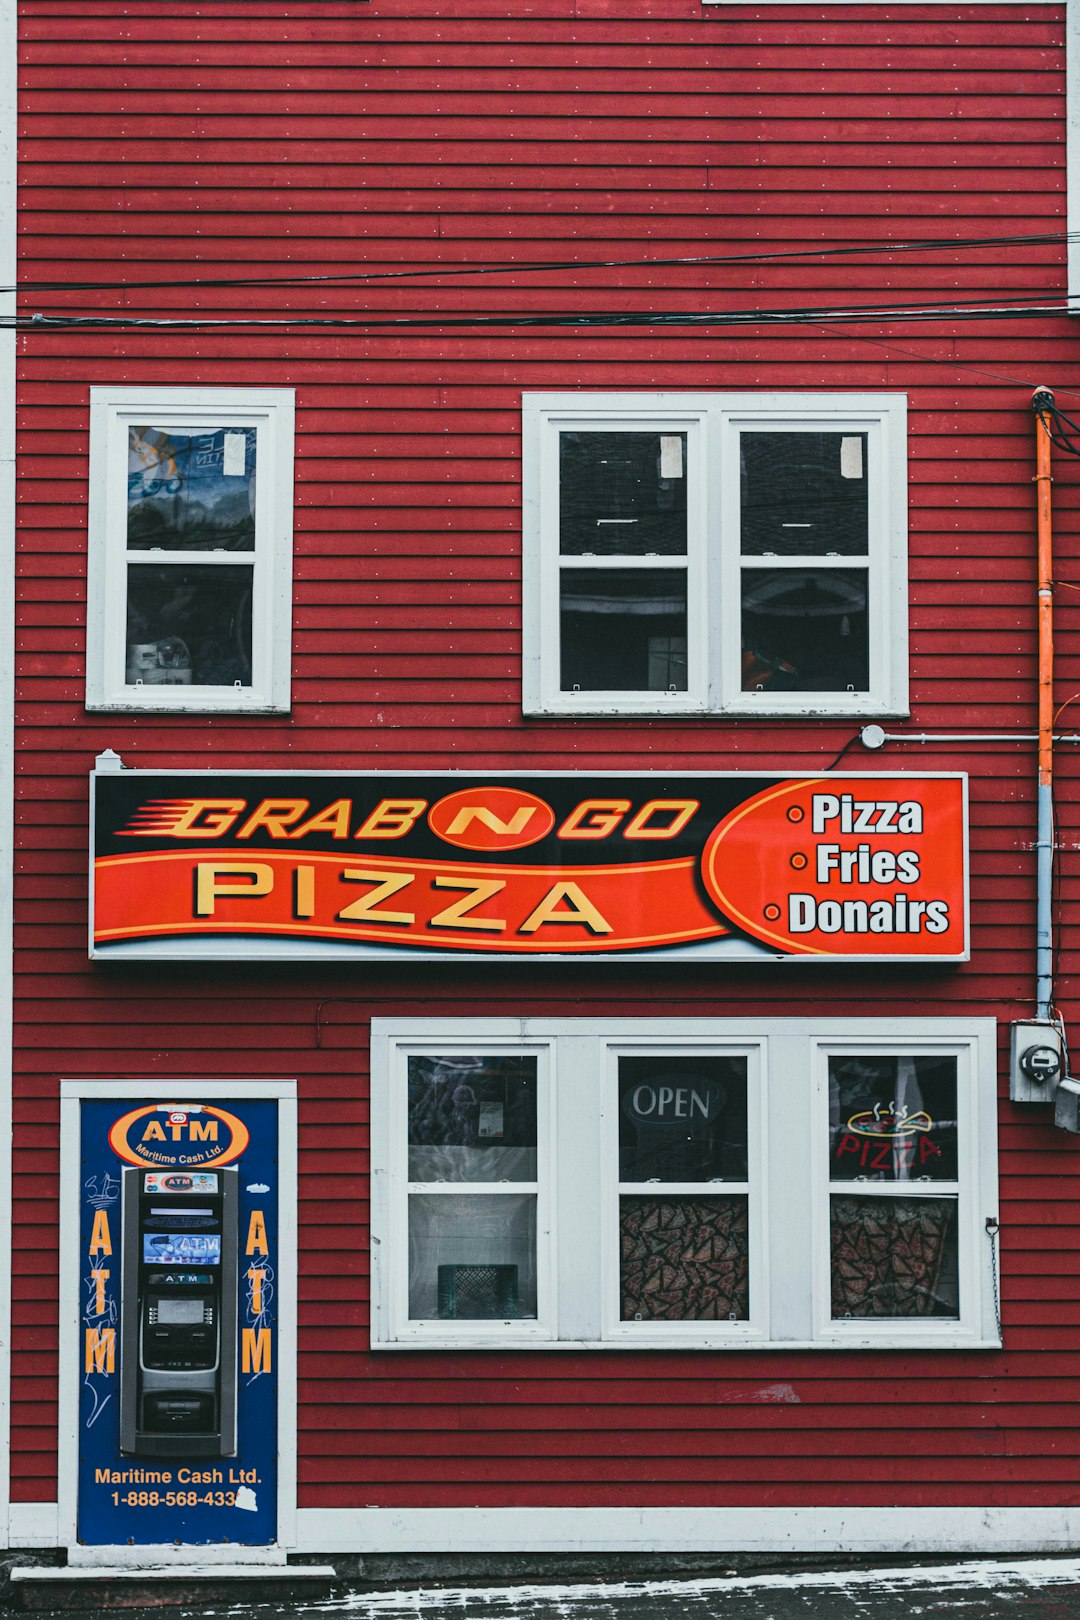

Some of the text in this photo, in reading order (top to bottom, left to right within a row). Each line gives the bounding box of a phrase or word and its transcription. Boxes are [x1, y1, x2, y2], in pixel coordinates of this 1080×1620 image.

[160, 798, 701, 840] GRAB N GO
[811, 794, 923, 835] Pizza
[816, 844, 920, 884] Fries
[193, 862, 614, 936] PIZZA
[788, 893, 950, 934] Donairs
[632, 1085, 710, 1119] OPEN
[141, 1120, 219, 1141] ATM
[135, 1143, 224, 1164] Maritime Cash Ltd.
[836, 1134, 943, 1169] PIZZA
[180, 1237, 219, 1251] ATM
[86, 1210, 115, 1374] ATM
[242, 1210, 272, 1374] ATM
[94, 1468, 262, 1484] Maritime Cash Ltd.
[111, 1491, 240, 1507] 1-888-568-433
